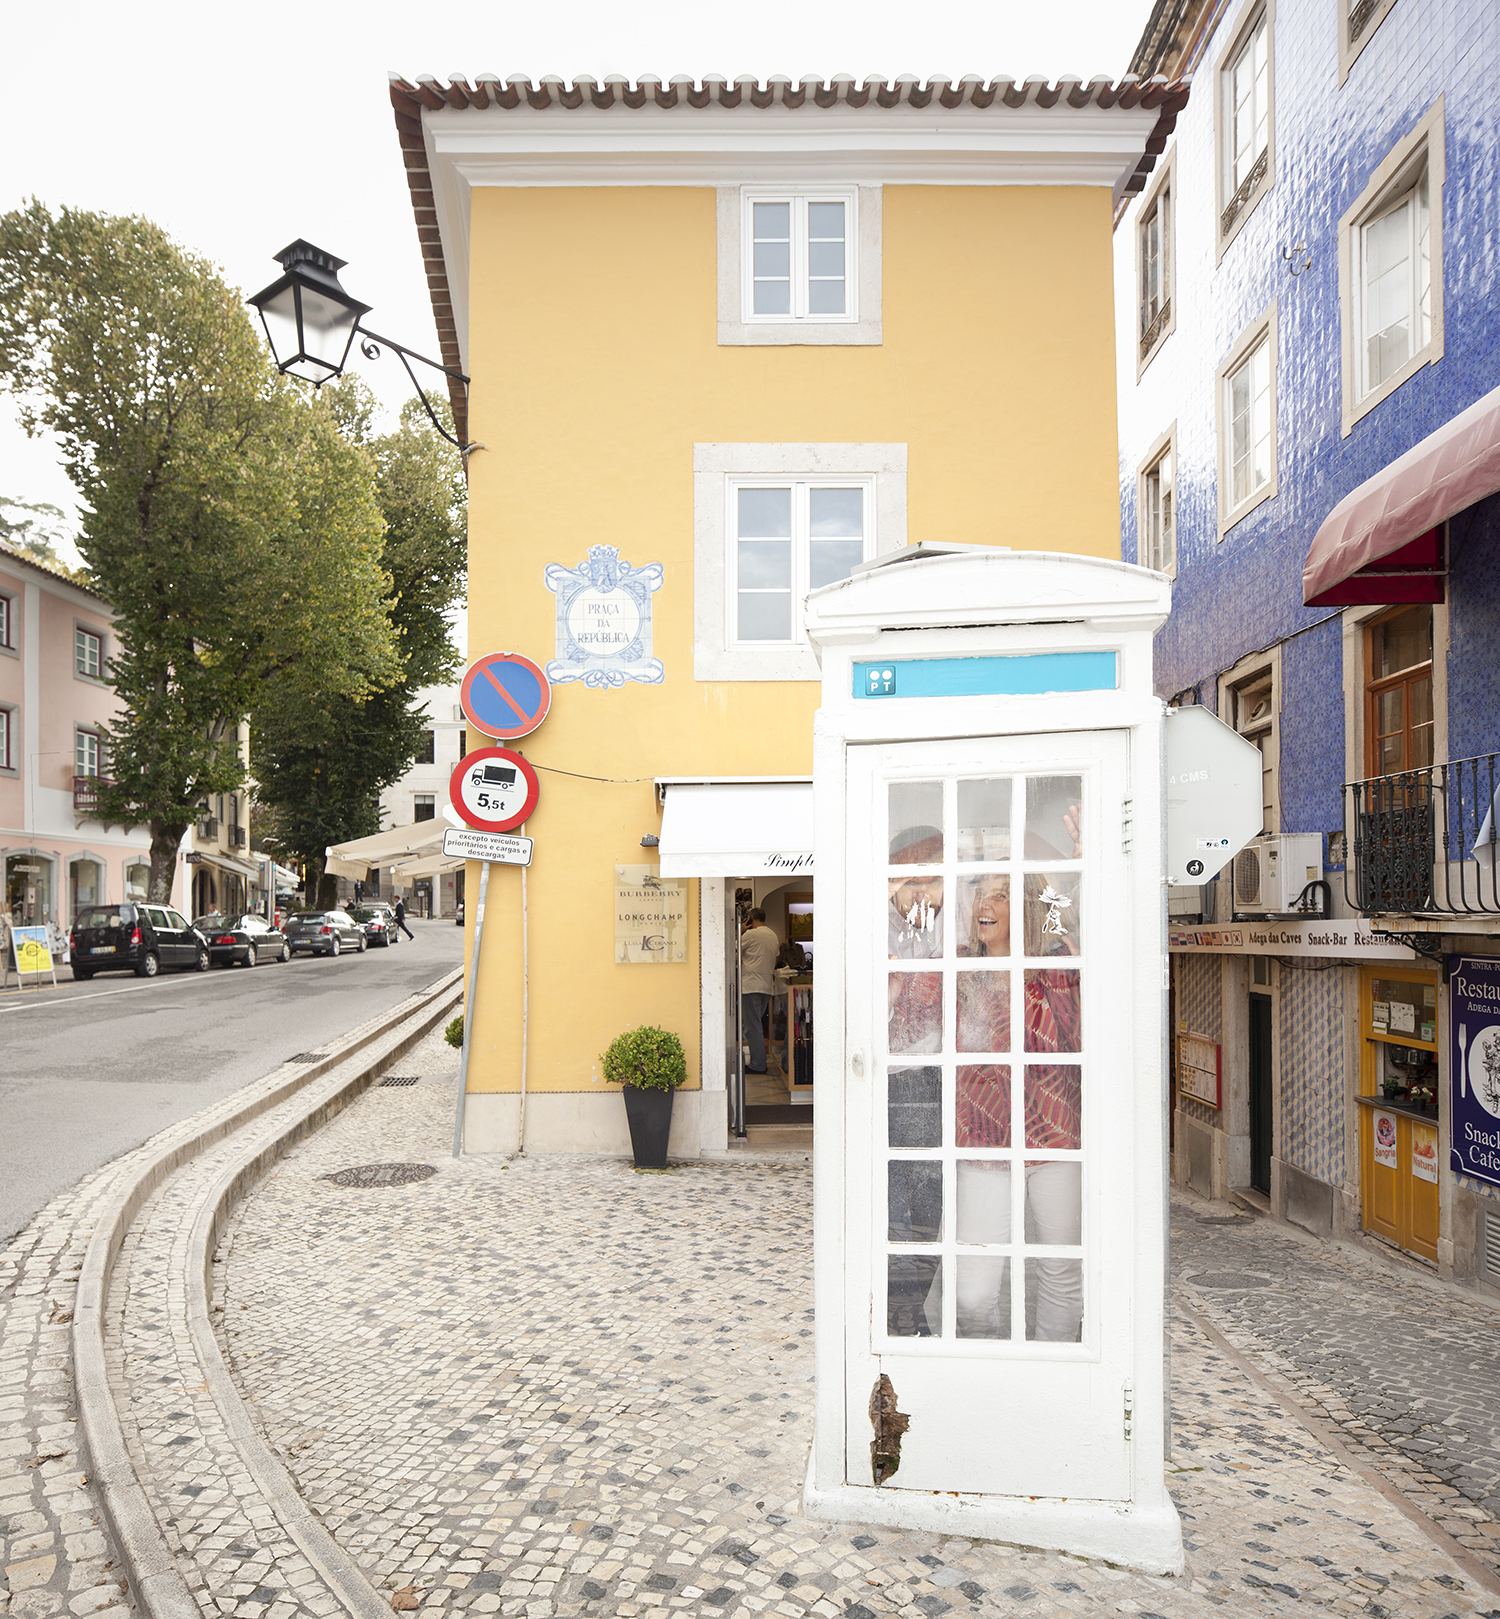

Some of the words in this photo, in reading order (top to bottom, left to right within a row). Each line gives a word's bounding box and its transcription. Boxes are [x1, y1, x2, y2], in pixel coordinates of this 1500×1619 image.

[588, 603, 619, 616] PRAÇA
[597, 619, 610, 628] DA
[577, 629, 630, 643] REPÚBLICA
[1179, 769, 1208, 783] CMS
[477, 793, 505, 810] 5,5t
[459, 834, 489, 843] excepto
[467, 848, 506, 859] descargas
[495, 846, 521, 854] cargas
[618, 913, 683, 921] LONGCHAMP
[1249, 931, 1268, 947] Adega
[1268, 932, 1279, 944] das
[1280, 931, 1302, 944] Caves
[1307, 932, 1348, 945] Snack-Bar
[1375, 1147, 1395, 1159] Sangria
[1413, 1155, 1437, 1174] Natural
